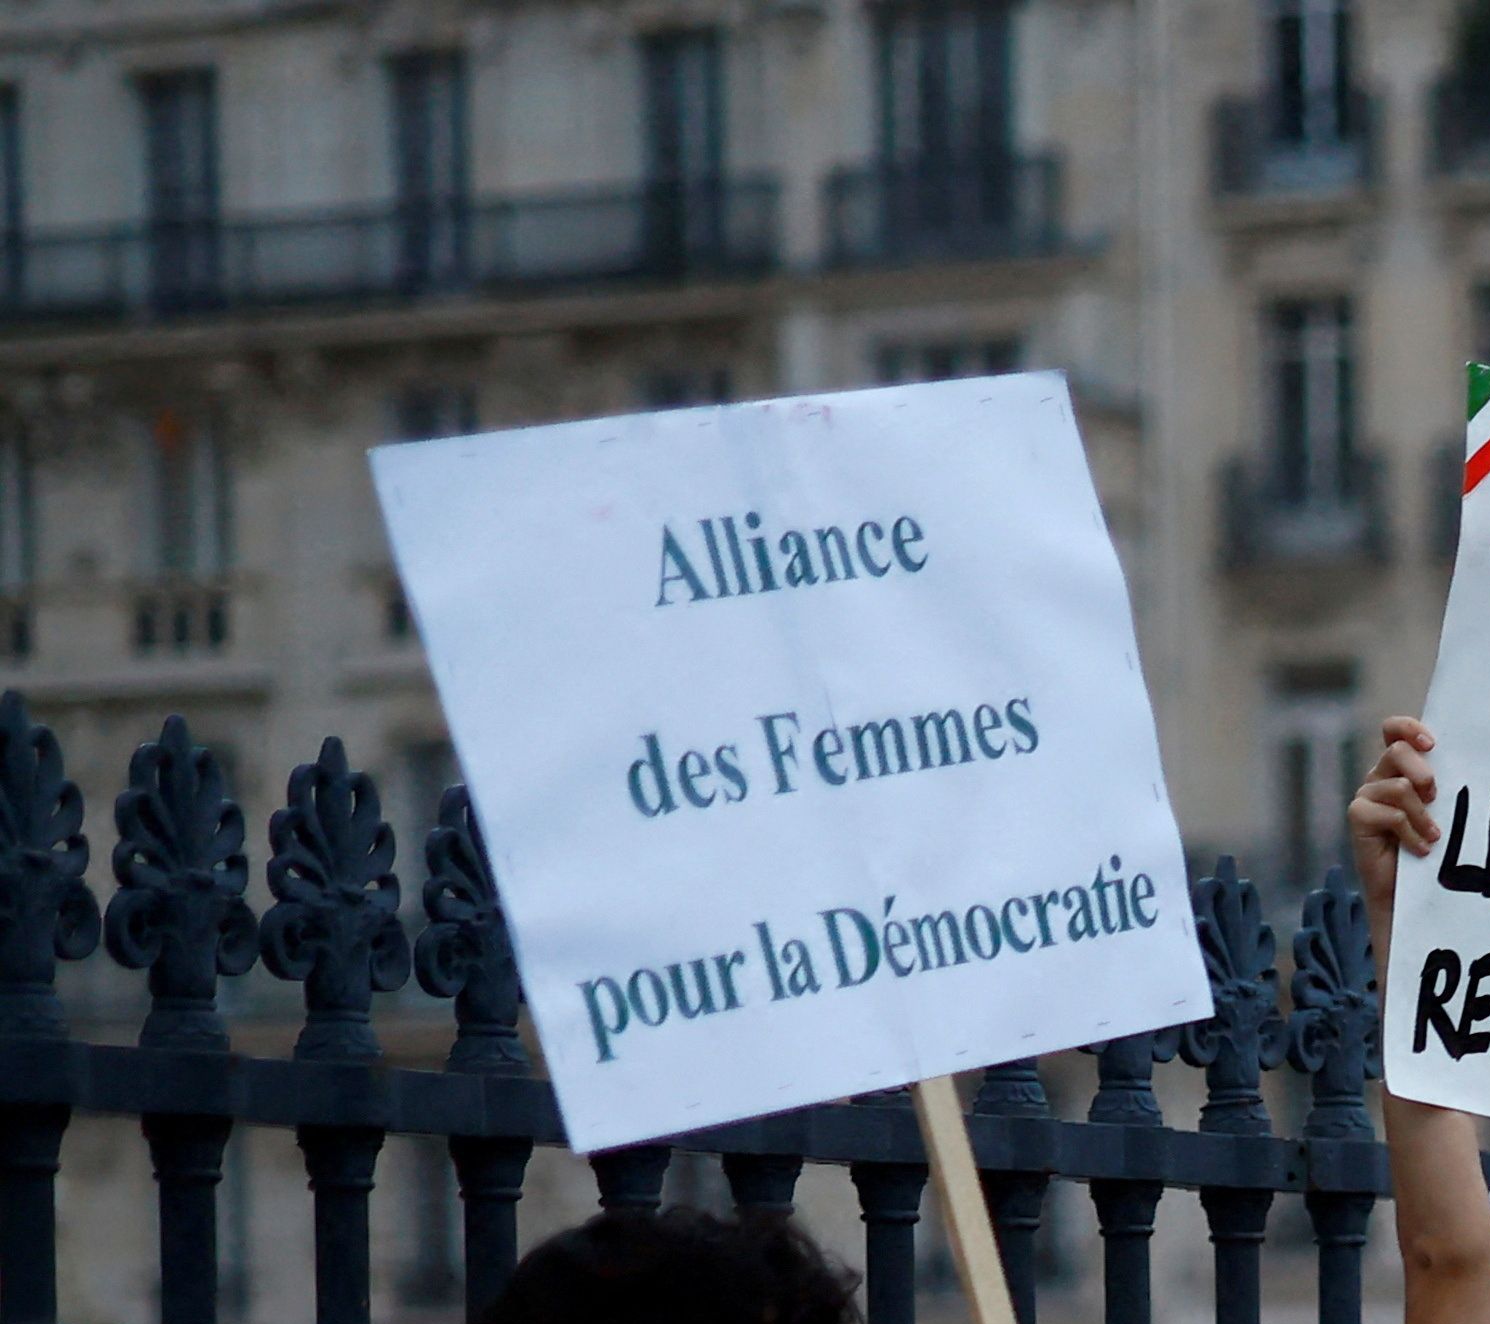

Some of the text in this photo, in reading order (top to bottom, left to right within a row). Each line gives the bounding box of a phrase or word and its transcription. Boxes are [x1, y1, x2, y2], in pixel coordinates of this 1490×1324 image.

[654, 510, 929, 607] Alliance
[626, 692, 1040, 819] des Femmes
[576, 853, 1160, 1063] pour la Démocratie
